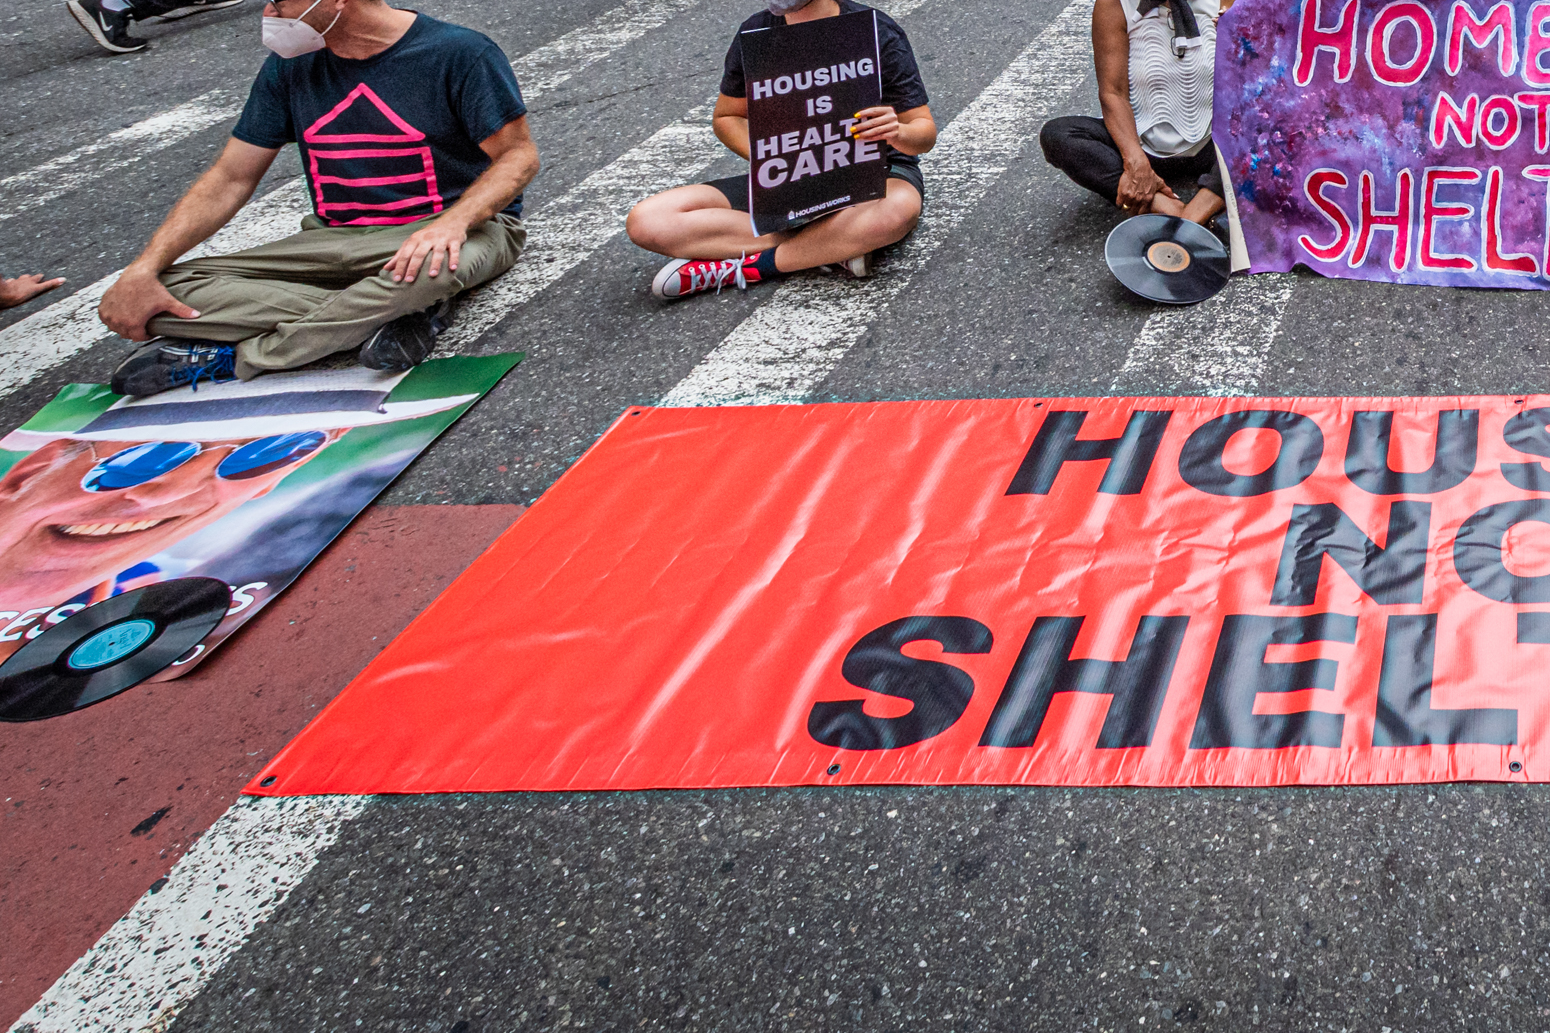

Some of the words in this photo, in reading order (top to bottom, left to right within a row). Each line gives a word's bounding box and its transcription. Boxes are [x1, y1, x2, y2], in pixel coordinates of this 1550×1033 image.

[752, 57, 874, 101] HOUSING
[806, 95, 833, 117] IS
[756, 116, 869, 160] HEALT
[757, 139, 881, 189] CARE
[795, 202, 826, 218] HOUSING
[825, 195, 851, 208] WORKS
